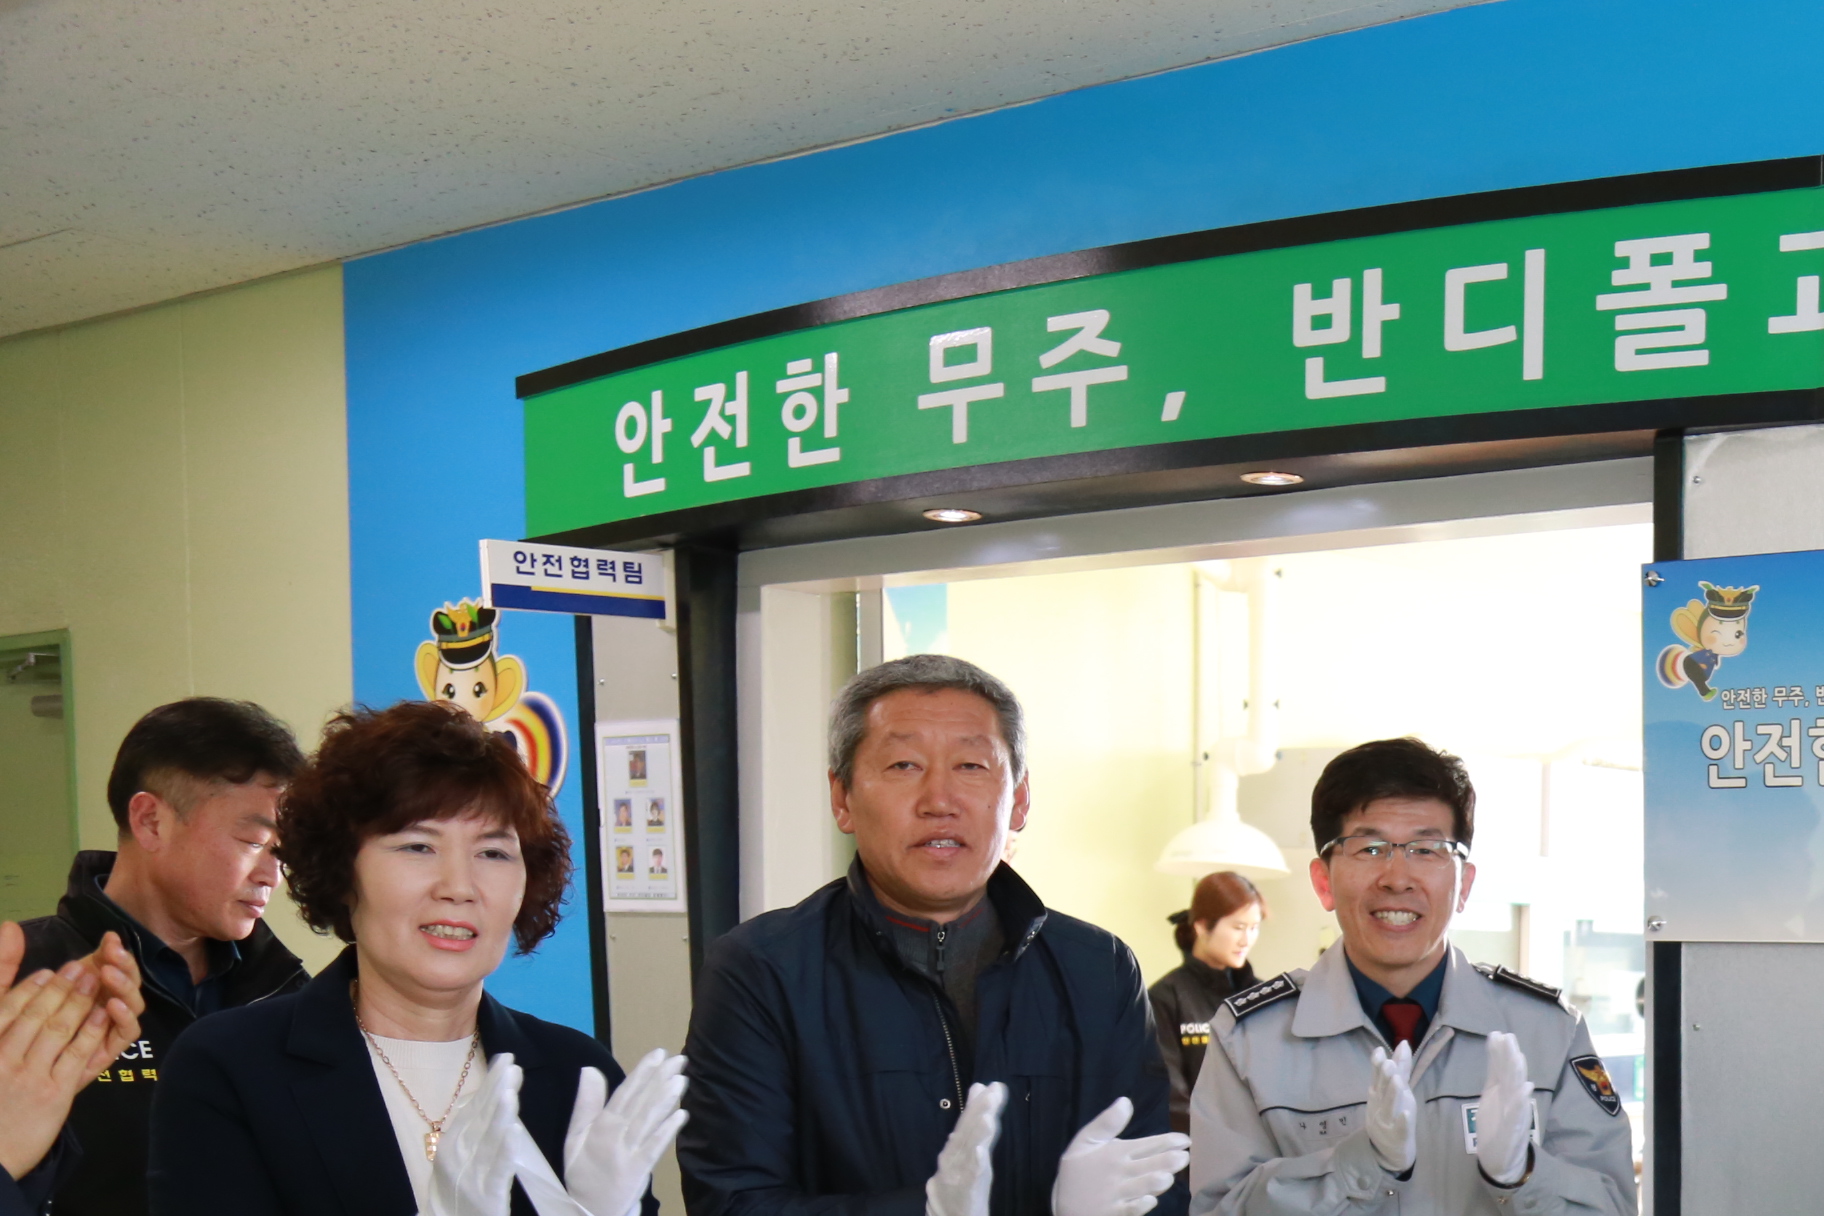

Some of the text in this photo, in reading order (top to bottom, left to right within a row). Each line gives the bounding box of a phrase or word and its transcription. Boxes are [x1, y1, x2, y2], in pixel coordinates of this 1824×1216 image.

[614, 351, 850, 499] 안전한
[916, 308, 1187, 445] 무주,
[513, 550, 644, 586] 안전협력팀
[1720, 687, 1768, 711] 안전한
[1771, 686, 1810, 708] 무주,
[1180, 1022, 1211, 1035] POLIC
